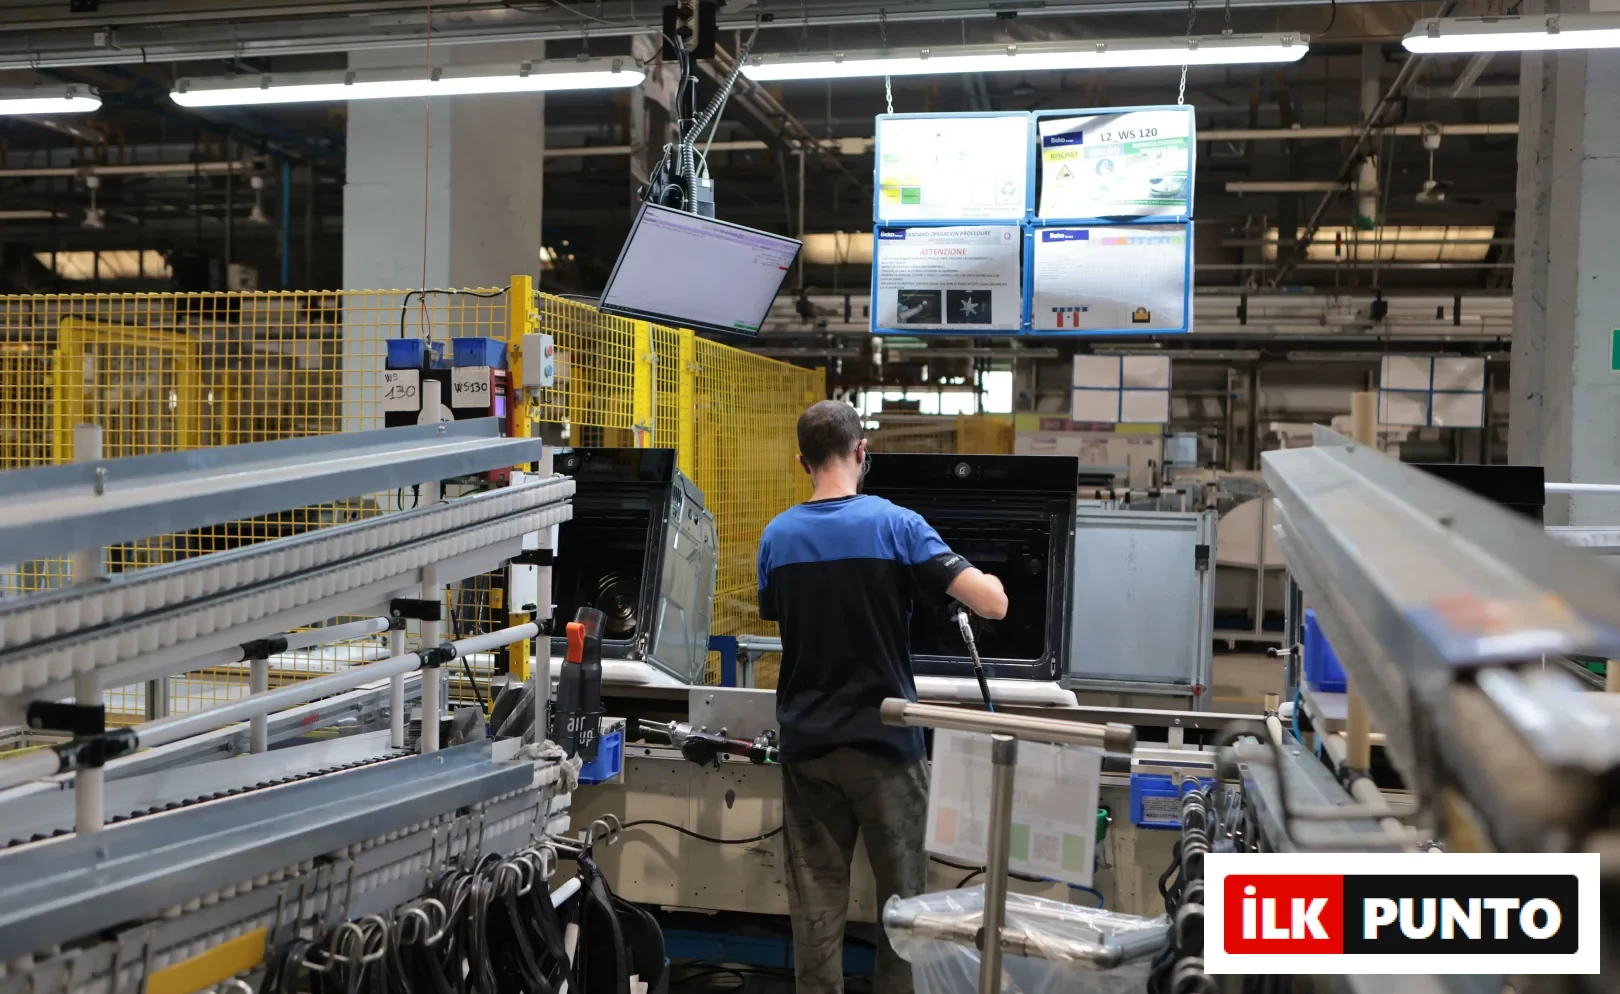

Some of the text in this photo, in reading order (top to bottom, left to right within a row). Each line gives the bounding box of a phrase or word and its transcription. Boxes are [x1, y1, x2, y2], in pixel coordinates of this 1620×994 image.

[1139, 127, 1158, 138] 120
[1050, 151, 1078, 160] RISCHIO
[384, 373, 399, 382] WS
[385, 385, 416, 400] 130
[454, 382, 488, 393] WS130
[567, 716, 587, 732] air
[579, 729, 594, 747] up
